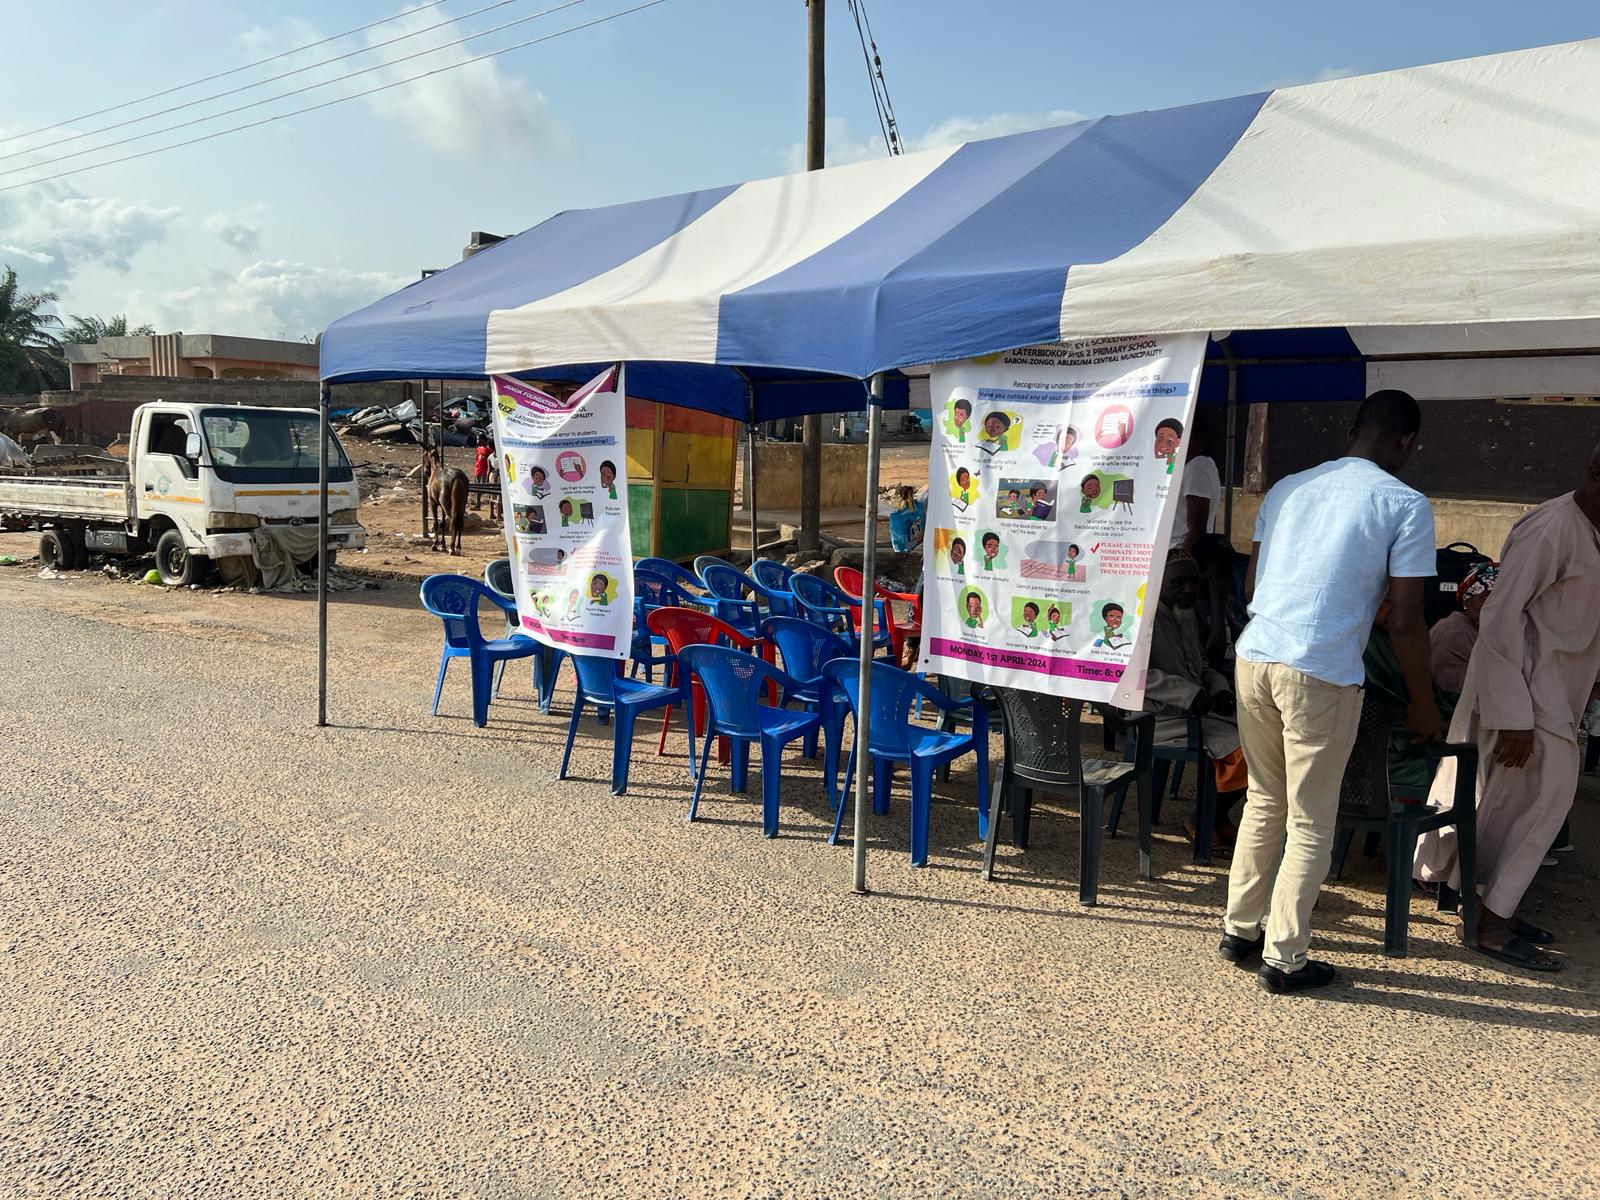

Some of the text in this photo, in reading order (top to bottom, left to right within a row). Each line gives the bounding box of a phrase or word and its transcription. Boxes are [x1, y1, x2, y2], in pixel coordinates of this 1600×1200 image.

[1093, 346, 1127, 356] PRIMARY
[1128, 340, 1157, 352] SCHOOL
[1004, 349, 1163, 366] SABON-ZONGO, ABLEKUMA CENTRAL MUNICIPALITY
[1013, 380, 1049, 389] Recognizing
[523, 392, 559, 408] FOUNDATION
[1007, 392, 1028, 400] noticed
[1152, 386, 1177, 394] things?
[950, 645, 984, 660] MONDAY,
[1000, 655, 1026, 665] APRIL
[1026, 658, 1047, 668] 2024
[1077, 664, 1102, 676] Time:
[1104, 668, 1114, 677] 8:
